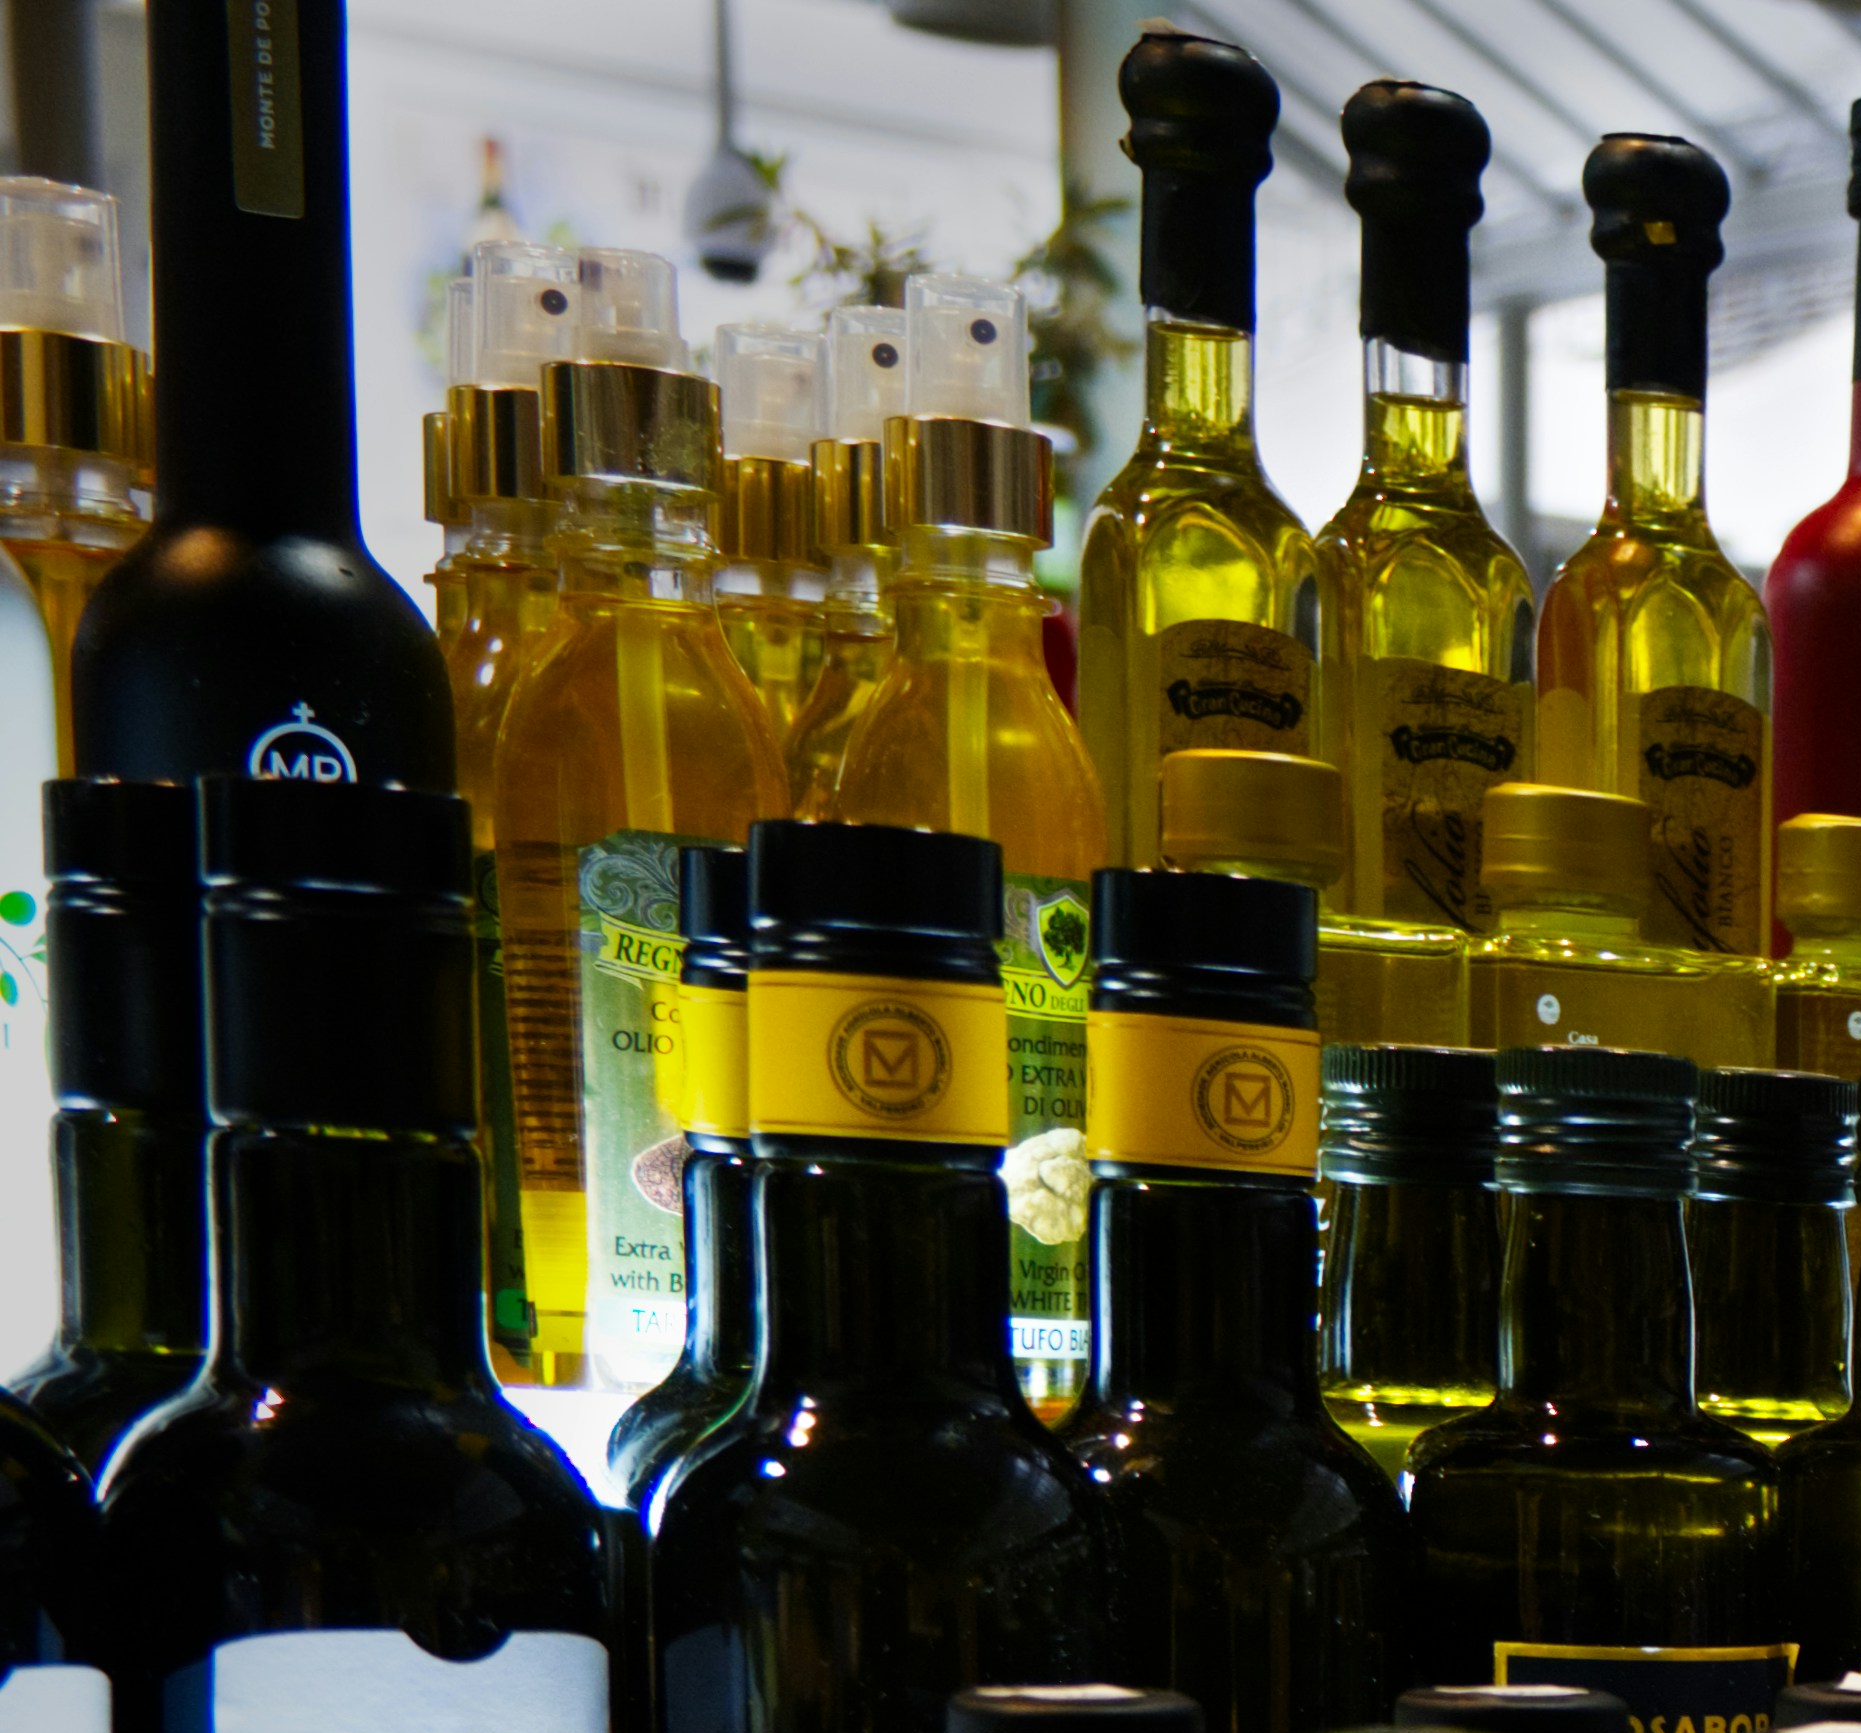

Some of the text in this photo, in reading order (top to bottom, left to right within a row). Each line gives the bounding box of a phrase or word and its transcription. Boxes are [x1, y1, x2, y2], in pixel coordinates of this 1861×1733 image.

[257, 37, 275, 150] MONTE DE
[1050, 994, 1085, 1013] DEGLI
[613, 1030, 674, 1055] OLIO
[1566, 1029, 1600, 1046] Casa
[1022, 1064, 1076, 1088] EXTRA
[1024, 1095, 1044, 1116] DI
[615, 1236, 671, 1261] Extra
[611, 1269, 659, 1293] with
[1010, 1290, 1074, 1313] WHITE
[1010, 1326, 1063, 1352] TUFO
